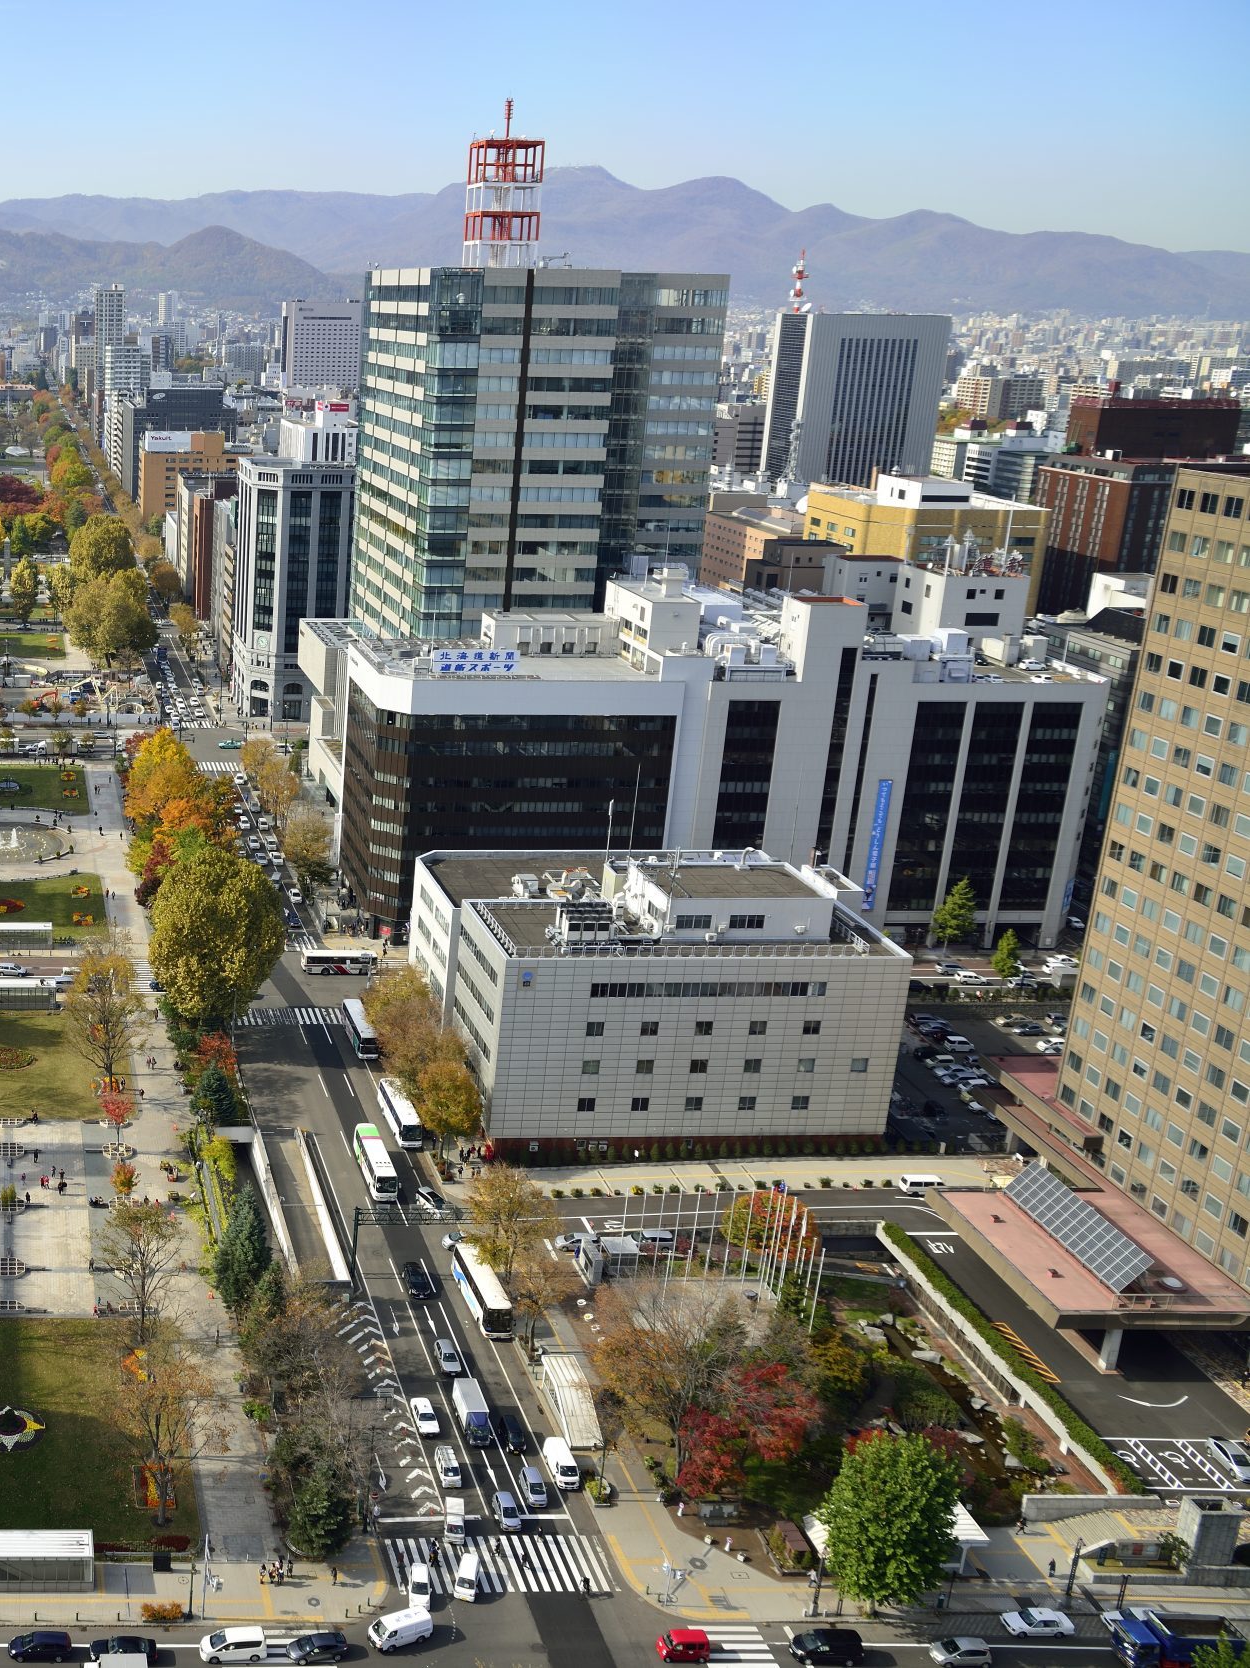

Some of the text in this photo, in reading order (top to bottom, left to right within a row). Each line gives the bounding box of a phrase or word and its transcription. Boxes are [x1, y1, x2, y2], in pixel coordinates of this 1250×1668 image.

[440, 652, 515, 661] 北海道新聞
